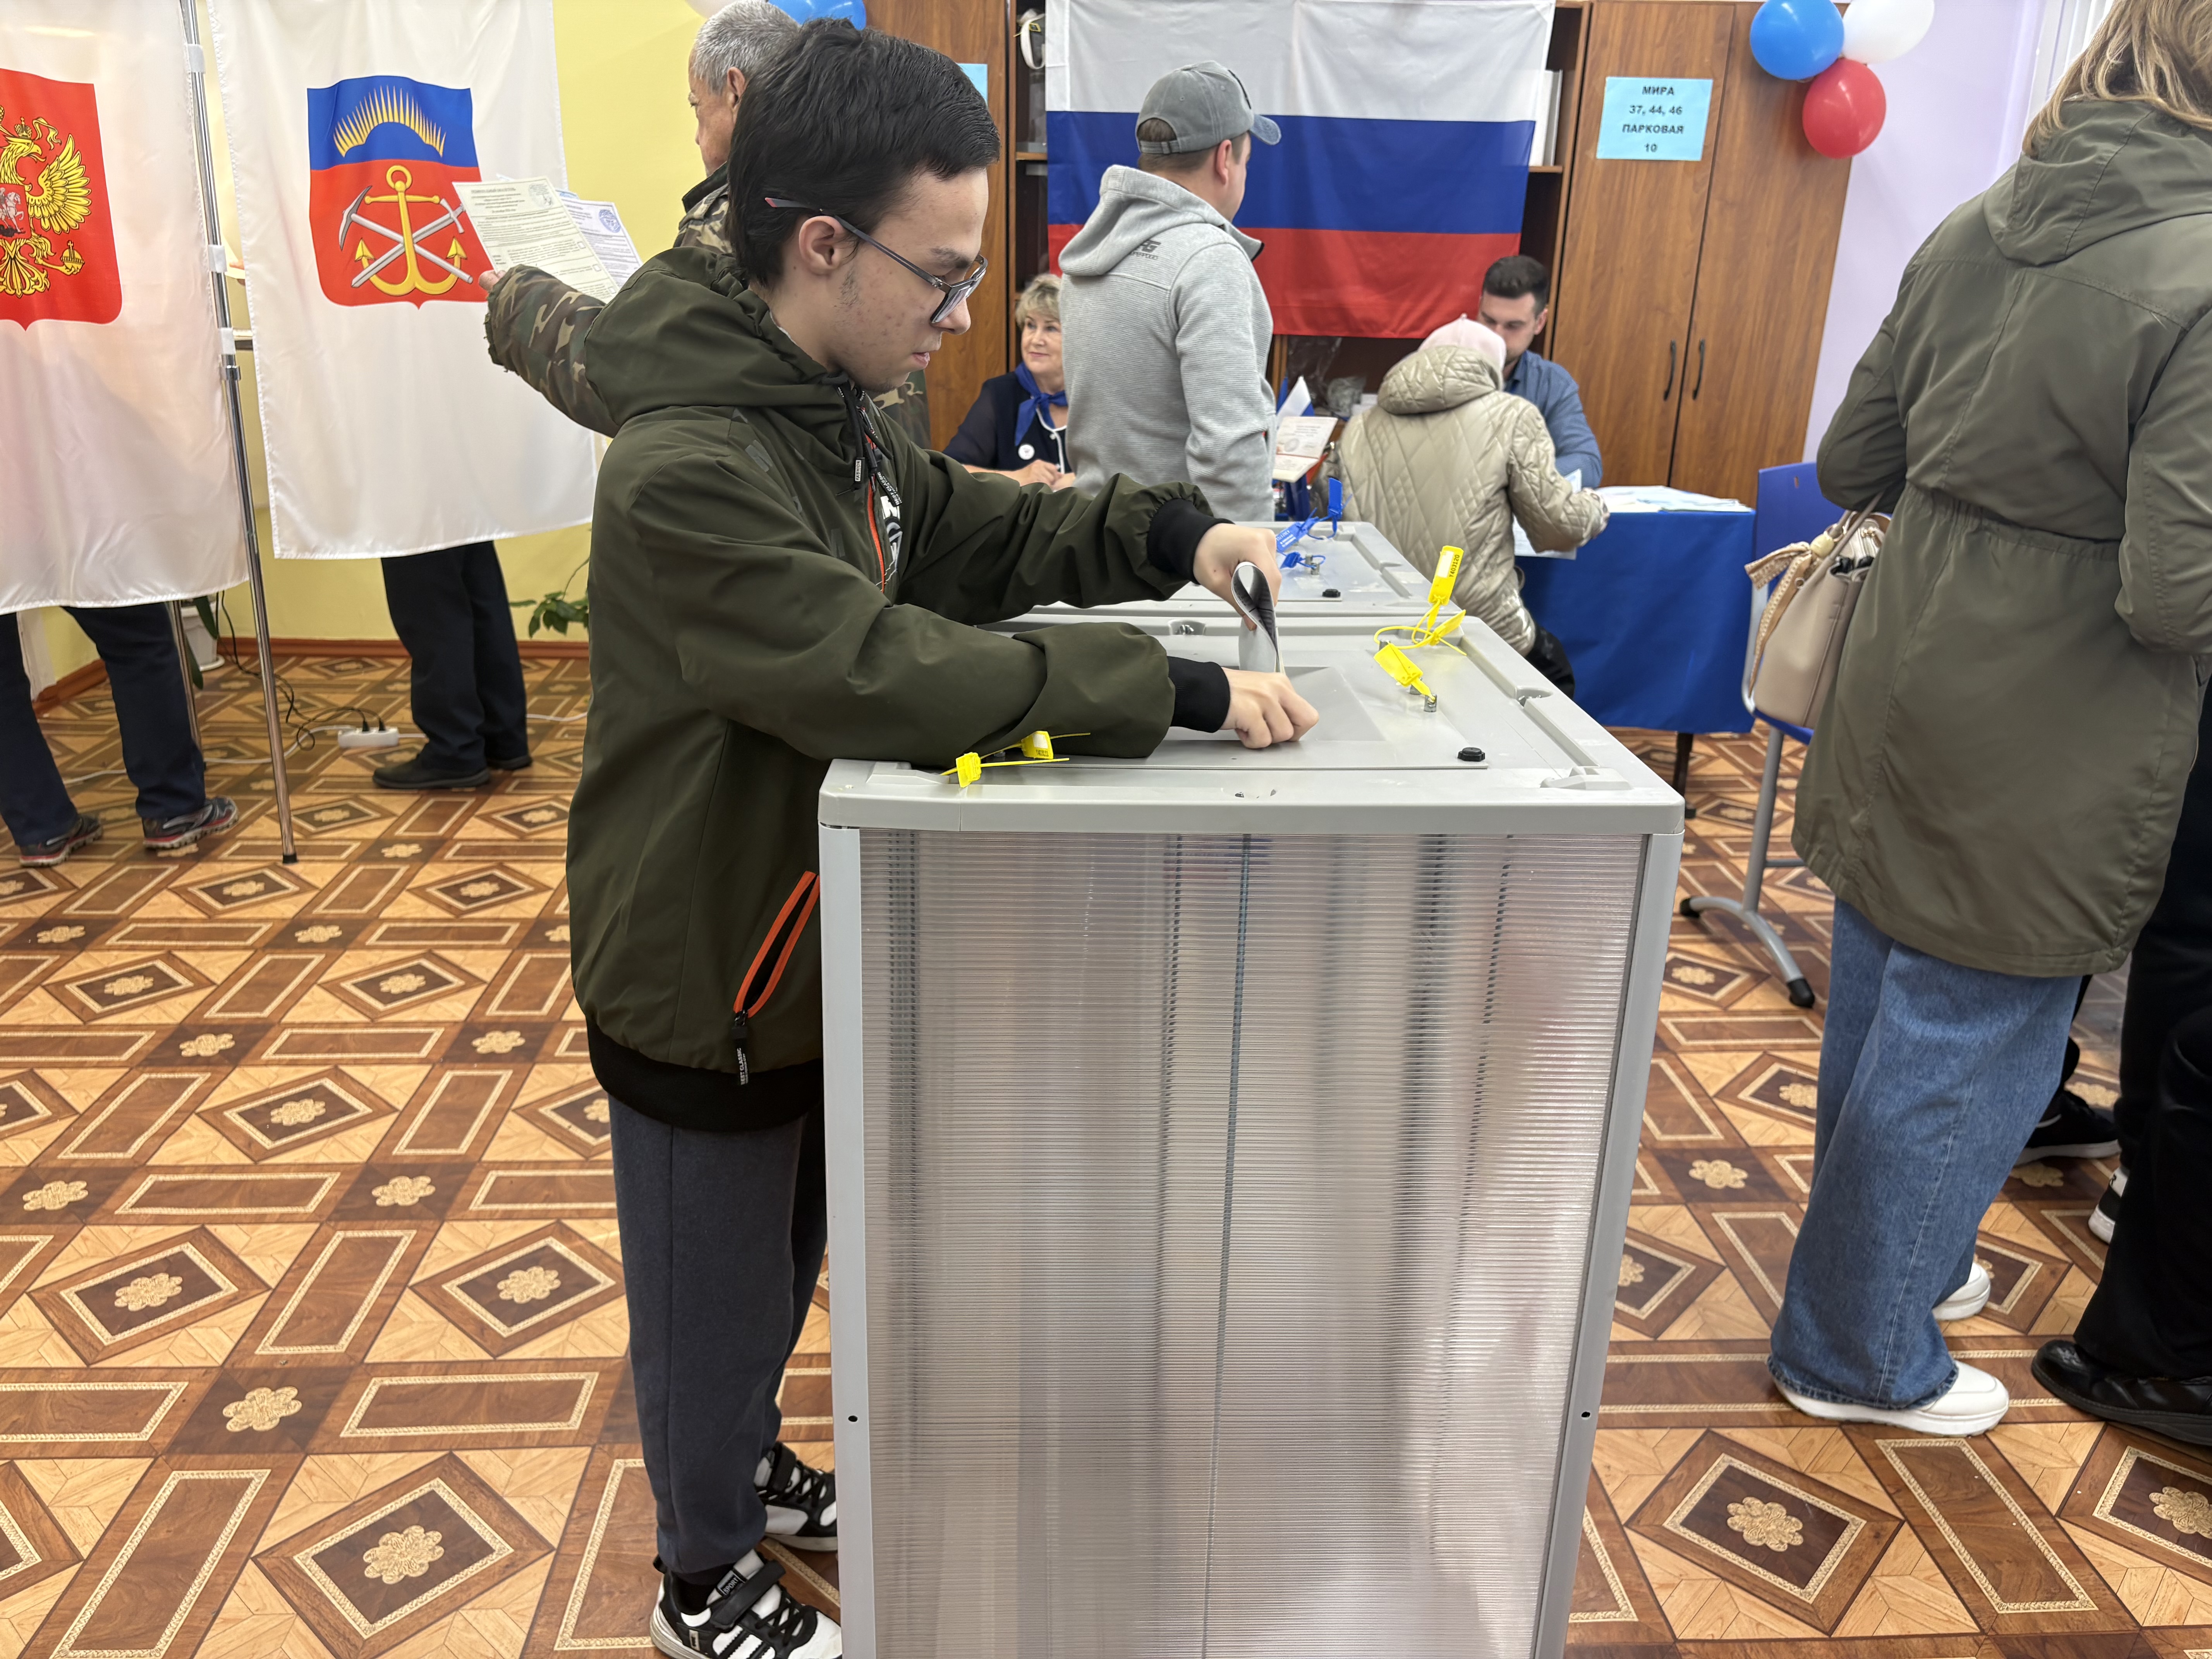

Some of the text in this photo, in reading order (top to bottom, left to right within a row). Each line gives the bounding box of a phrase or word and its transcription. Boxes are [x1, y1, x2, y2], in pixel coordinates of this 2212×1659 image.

[1642, 86, 1674, 96] МИРА
[1629, 105, 1683, 116] 37, 44, 46
[1622, 124, 1685, 134] ПАРКОВАЯ
[1645, 143, 1657, 152] 10
[723, 1577, 739, 1595] SPORT
